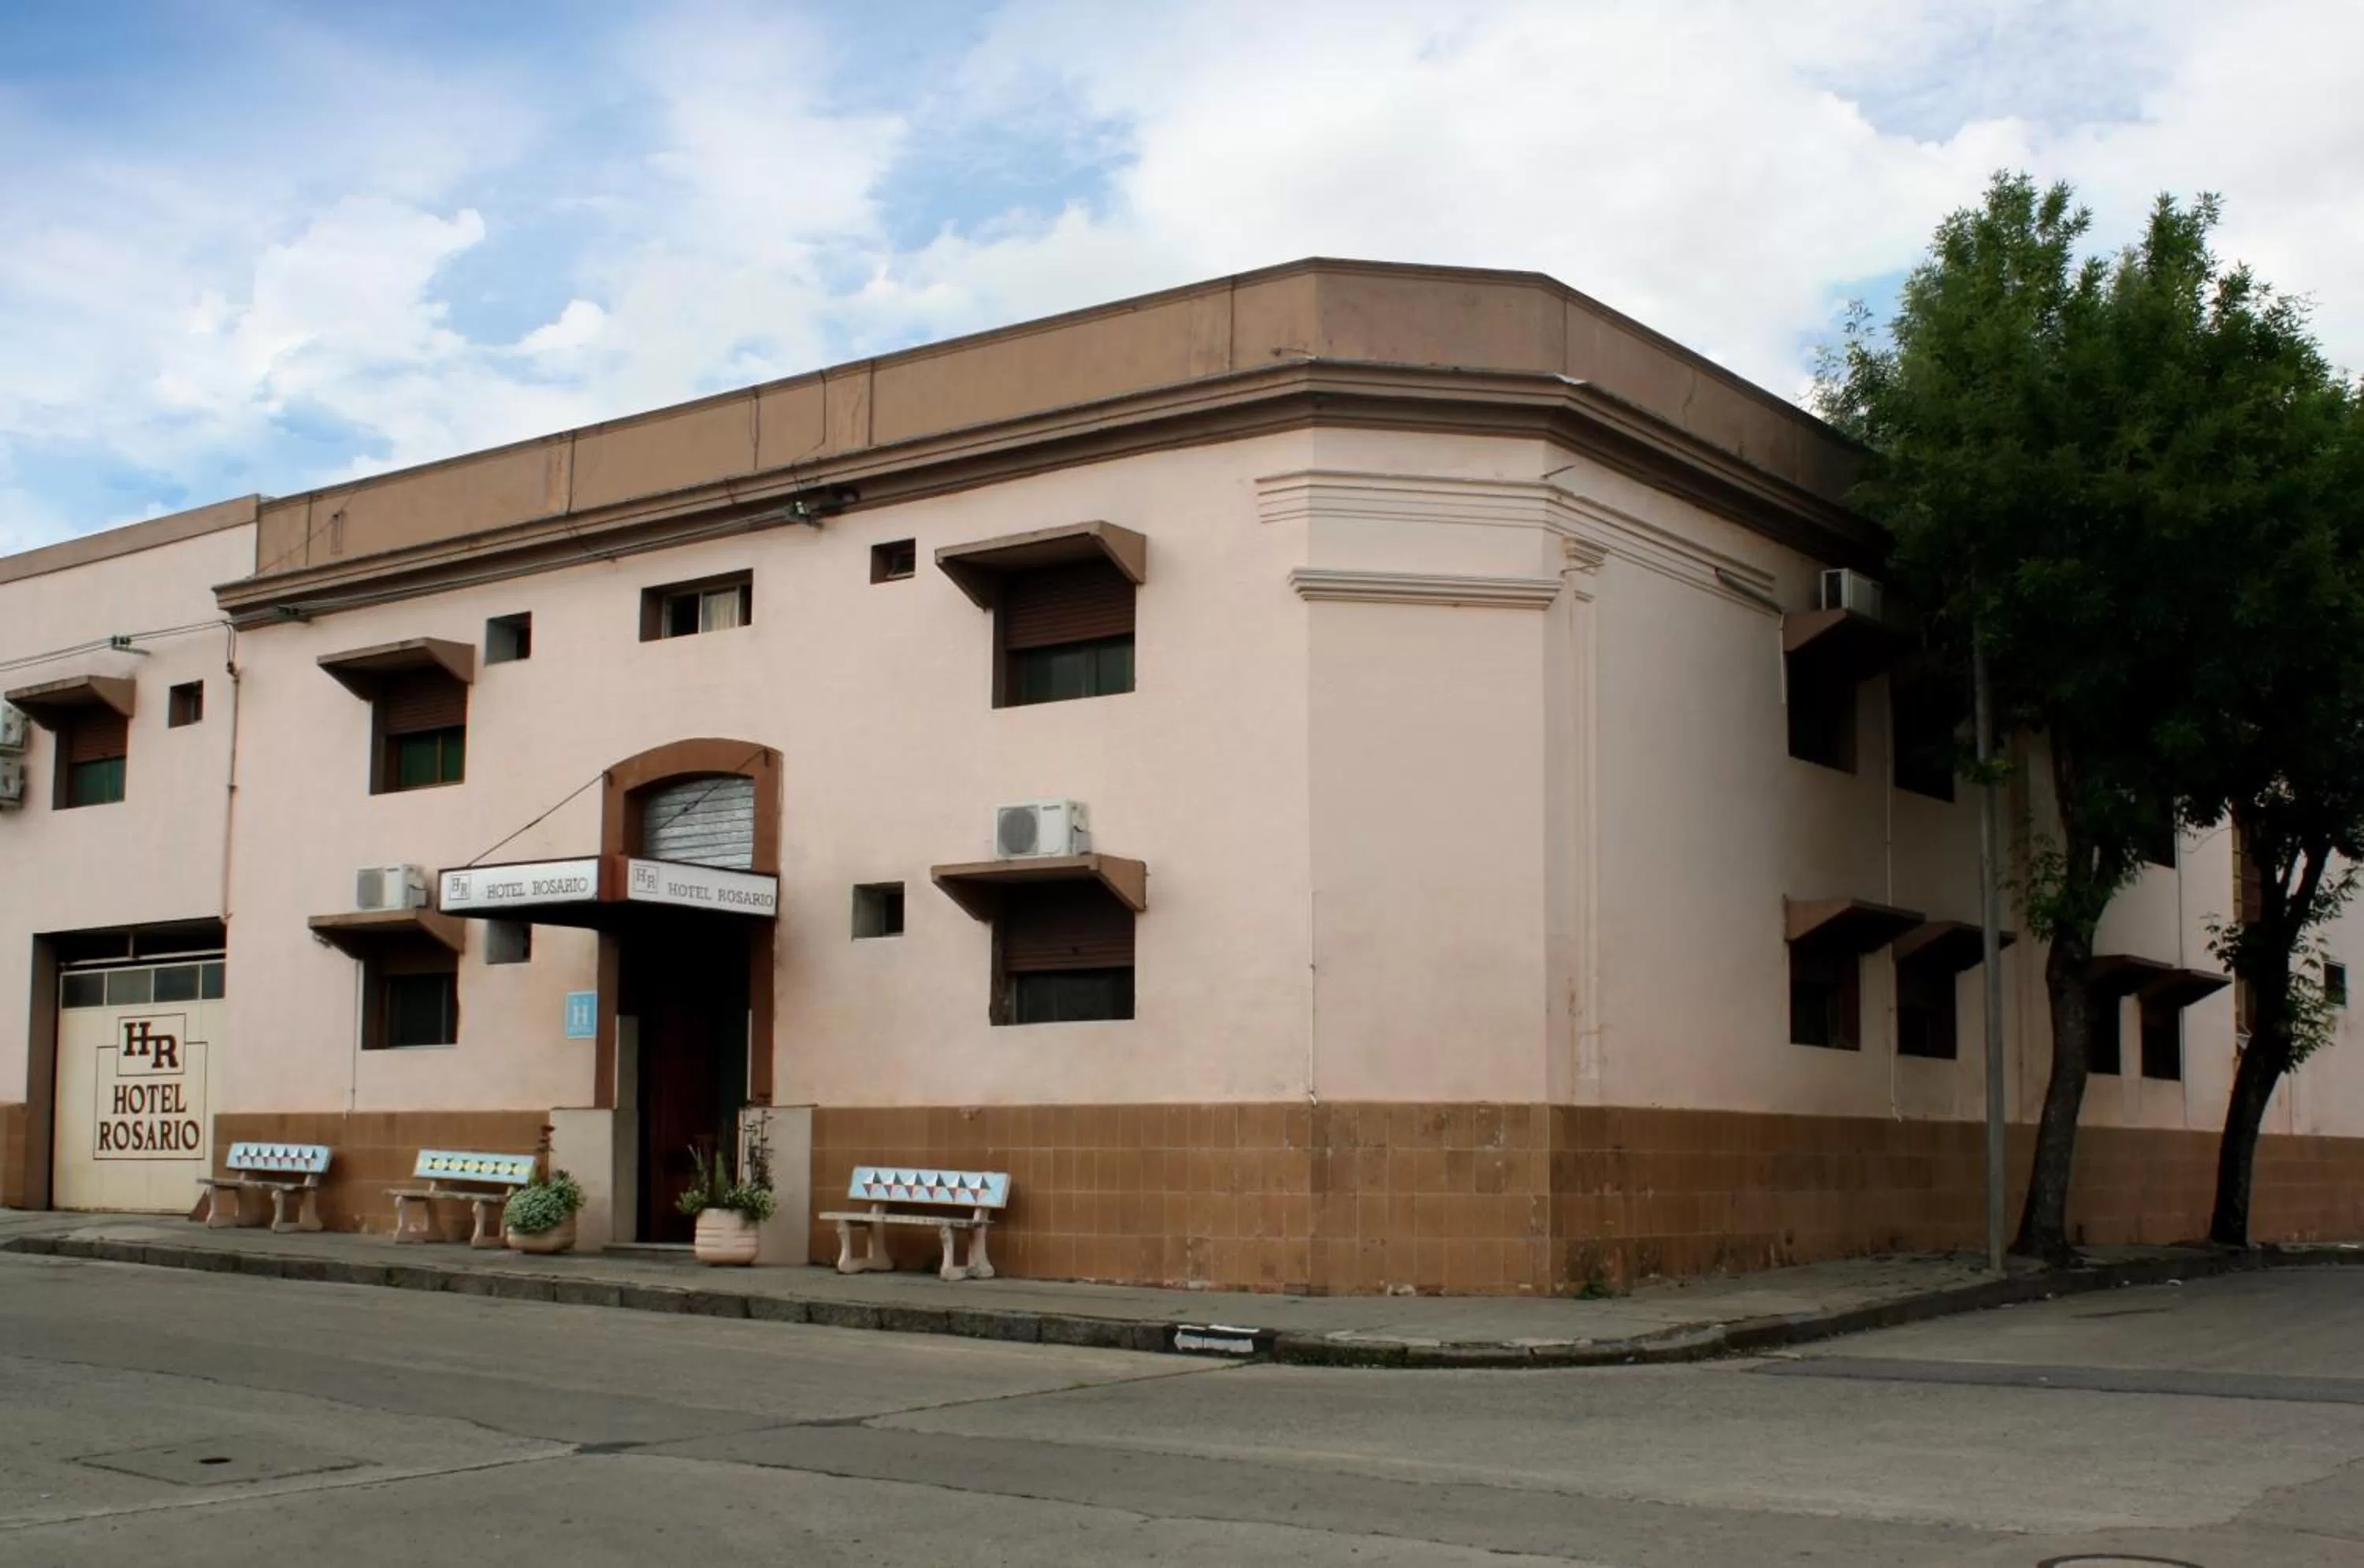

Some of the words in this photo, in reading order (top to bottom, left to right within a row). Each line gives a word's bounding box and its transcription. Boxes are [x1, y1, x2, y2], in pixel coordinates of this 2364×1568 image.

[486, 881, 526, 899] HOTEL
[531, 877, 588, 896] ROSARIO
[667, 882, 712, 901] HOTEL
[718, 889, 775, 908] ROSARIO
[572, 1005, 589, 1025] H
[123, 1021, 179, 1068] HR
[113, 1083, 187, 1114] HOTEL
[98, 1120, 200, 1151] ROSARIO
